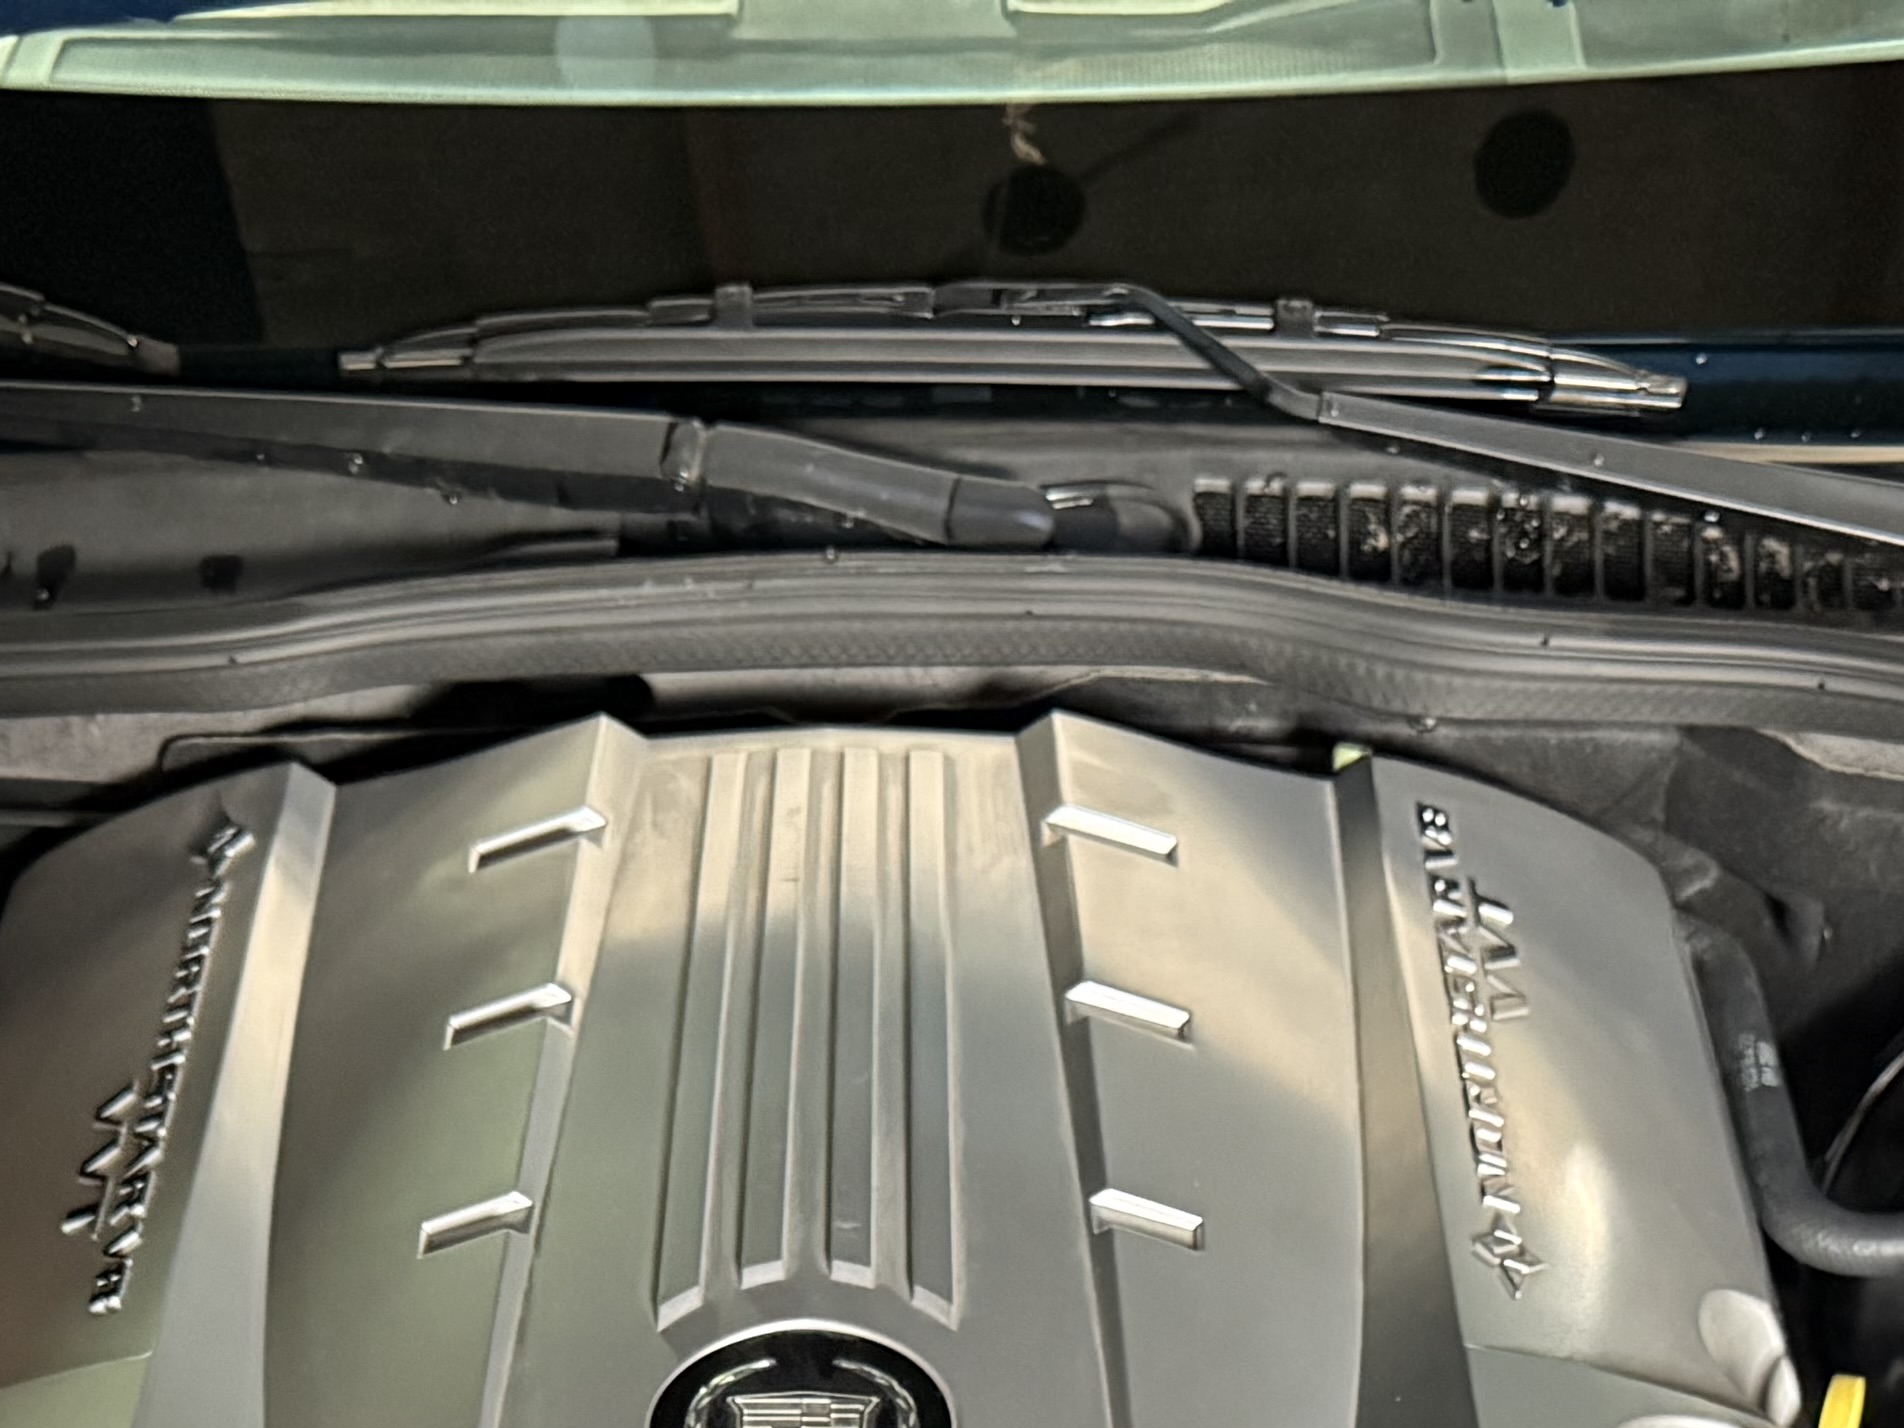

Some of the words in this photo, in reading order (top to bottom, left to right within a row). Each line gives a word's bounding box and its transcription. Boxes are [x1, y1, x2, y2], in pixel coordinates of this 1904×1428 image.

[1415, 800, 1460, 870] V8
[1466, 874, 1532, 1023] VVT
[109, 880, 231, 1226] NORTHSTAR
[1428, 874, 1522, 1216] NORTHSTAR
[60, 1076, 141, 1242] VVT
[88, 1218, 144, 1316] V8
